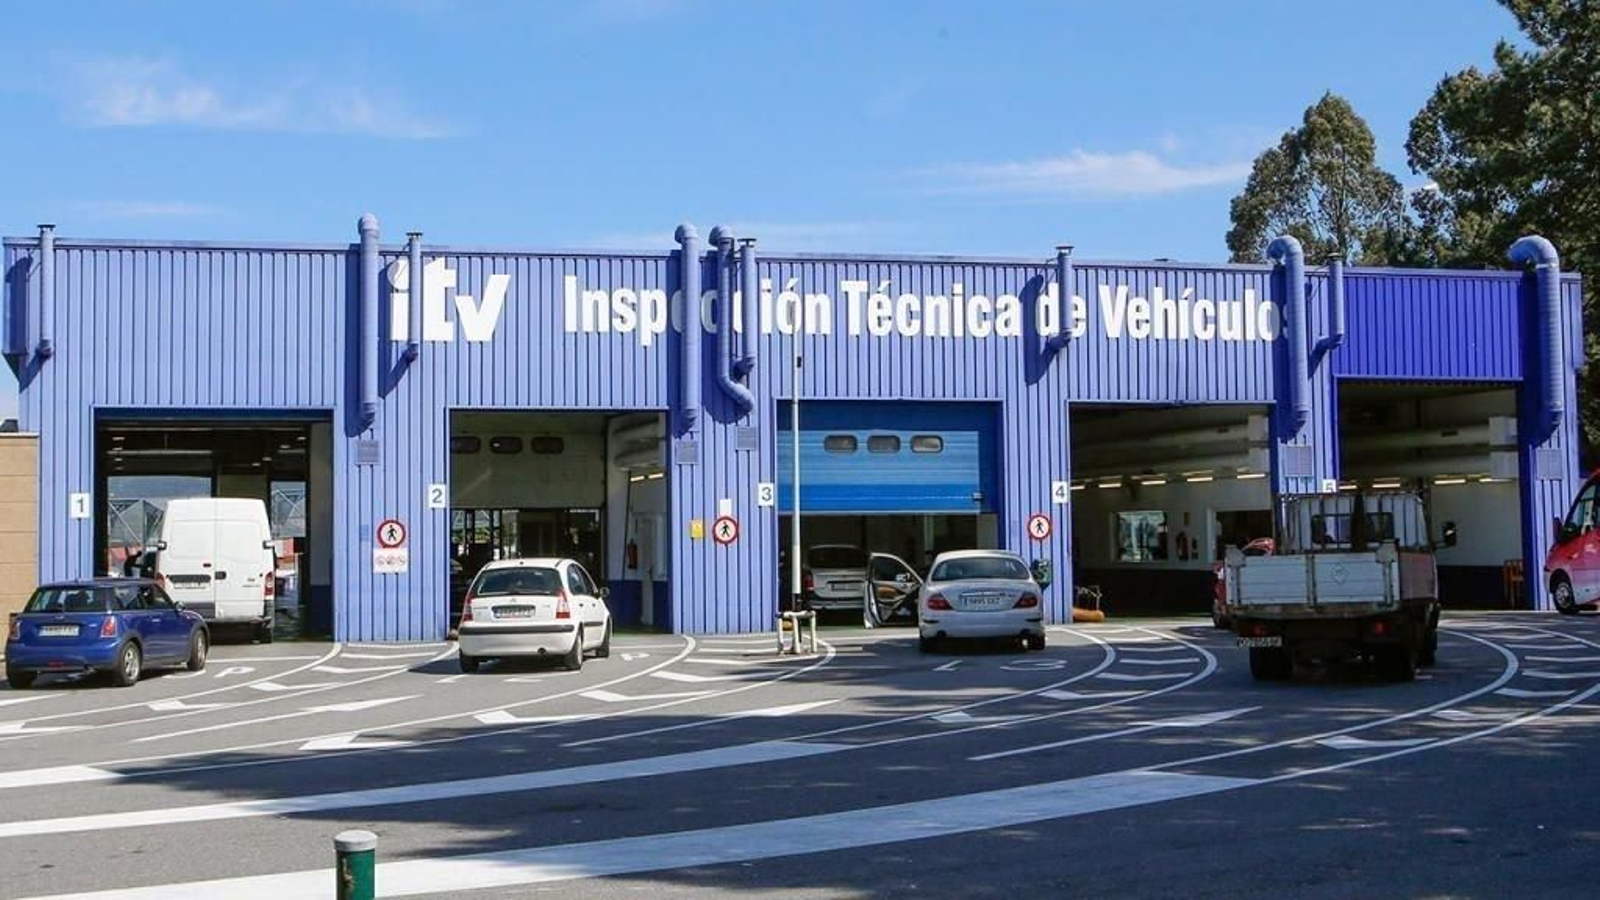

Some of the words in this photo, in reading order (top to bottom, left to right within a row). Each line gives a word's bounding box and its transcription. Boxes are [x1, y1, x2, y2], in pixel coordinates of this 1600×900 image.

[387, 257, 511, 341] itv
[841, 280, 1023, 339] Técnica
[1035, 283, 1087, 337] de
[1099, 285, 1289, 341] Vehículo
[432, 487, 442, 503] 2
[761, 487, 772, 502] 3
[1055, 485, 1066, 500] 4
[75, 497, 84, 513] 1
